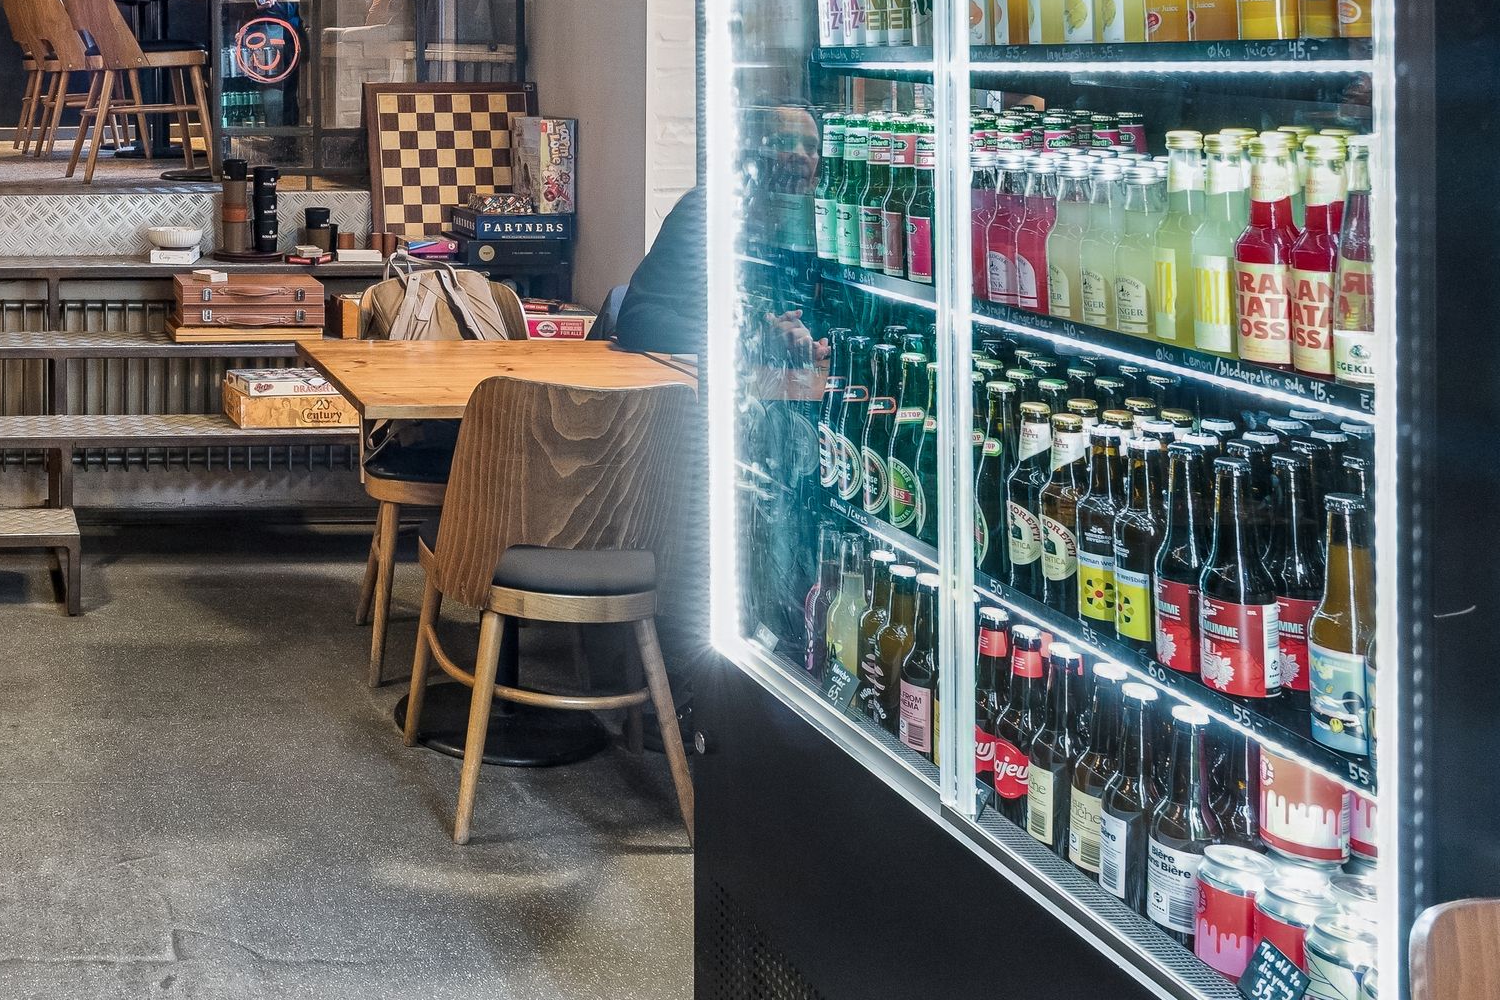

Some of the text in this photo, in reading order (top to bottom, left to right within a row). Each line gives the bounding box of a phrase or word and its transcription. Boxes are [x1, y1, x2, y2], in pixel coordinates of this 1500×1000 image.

[1244, 44, 1276, 60] juice
[484, 223, 563, 232] PARTNERS
[1118, 307, 1144, 317] NGER
[1337, 360, 1374, 374] EGEKIL
[293, 384, 335, 393] DRAUGHT
[302, 408, 342, 423] Century
[1203, 619, 1239, 639] MUMME
[1151, 844, 1175, 864] Bière
[1161, 861, 1192, 880] Bière
